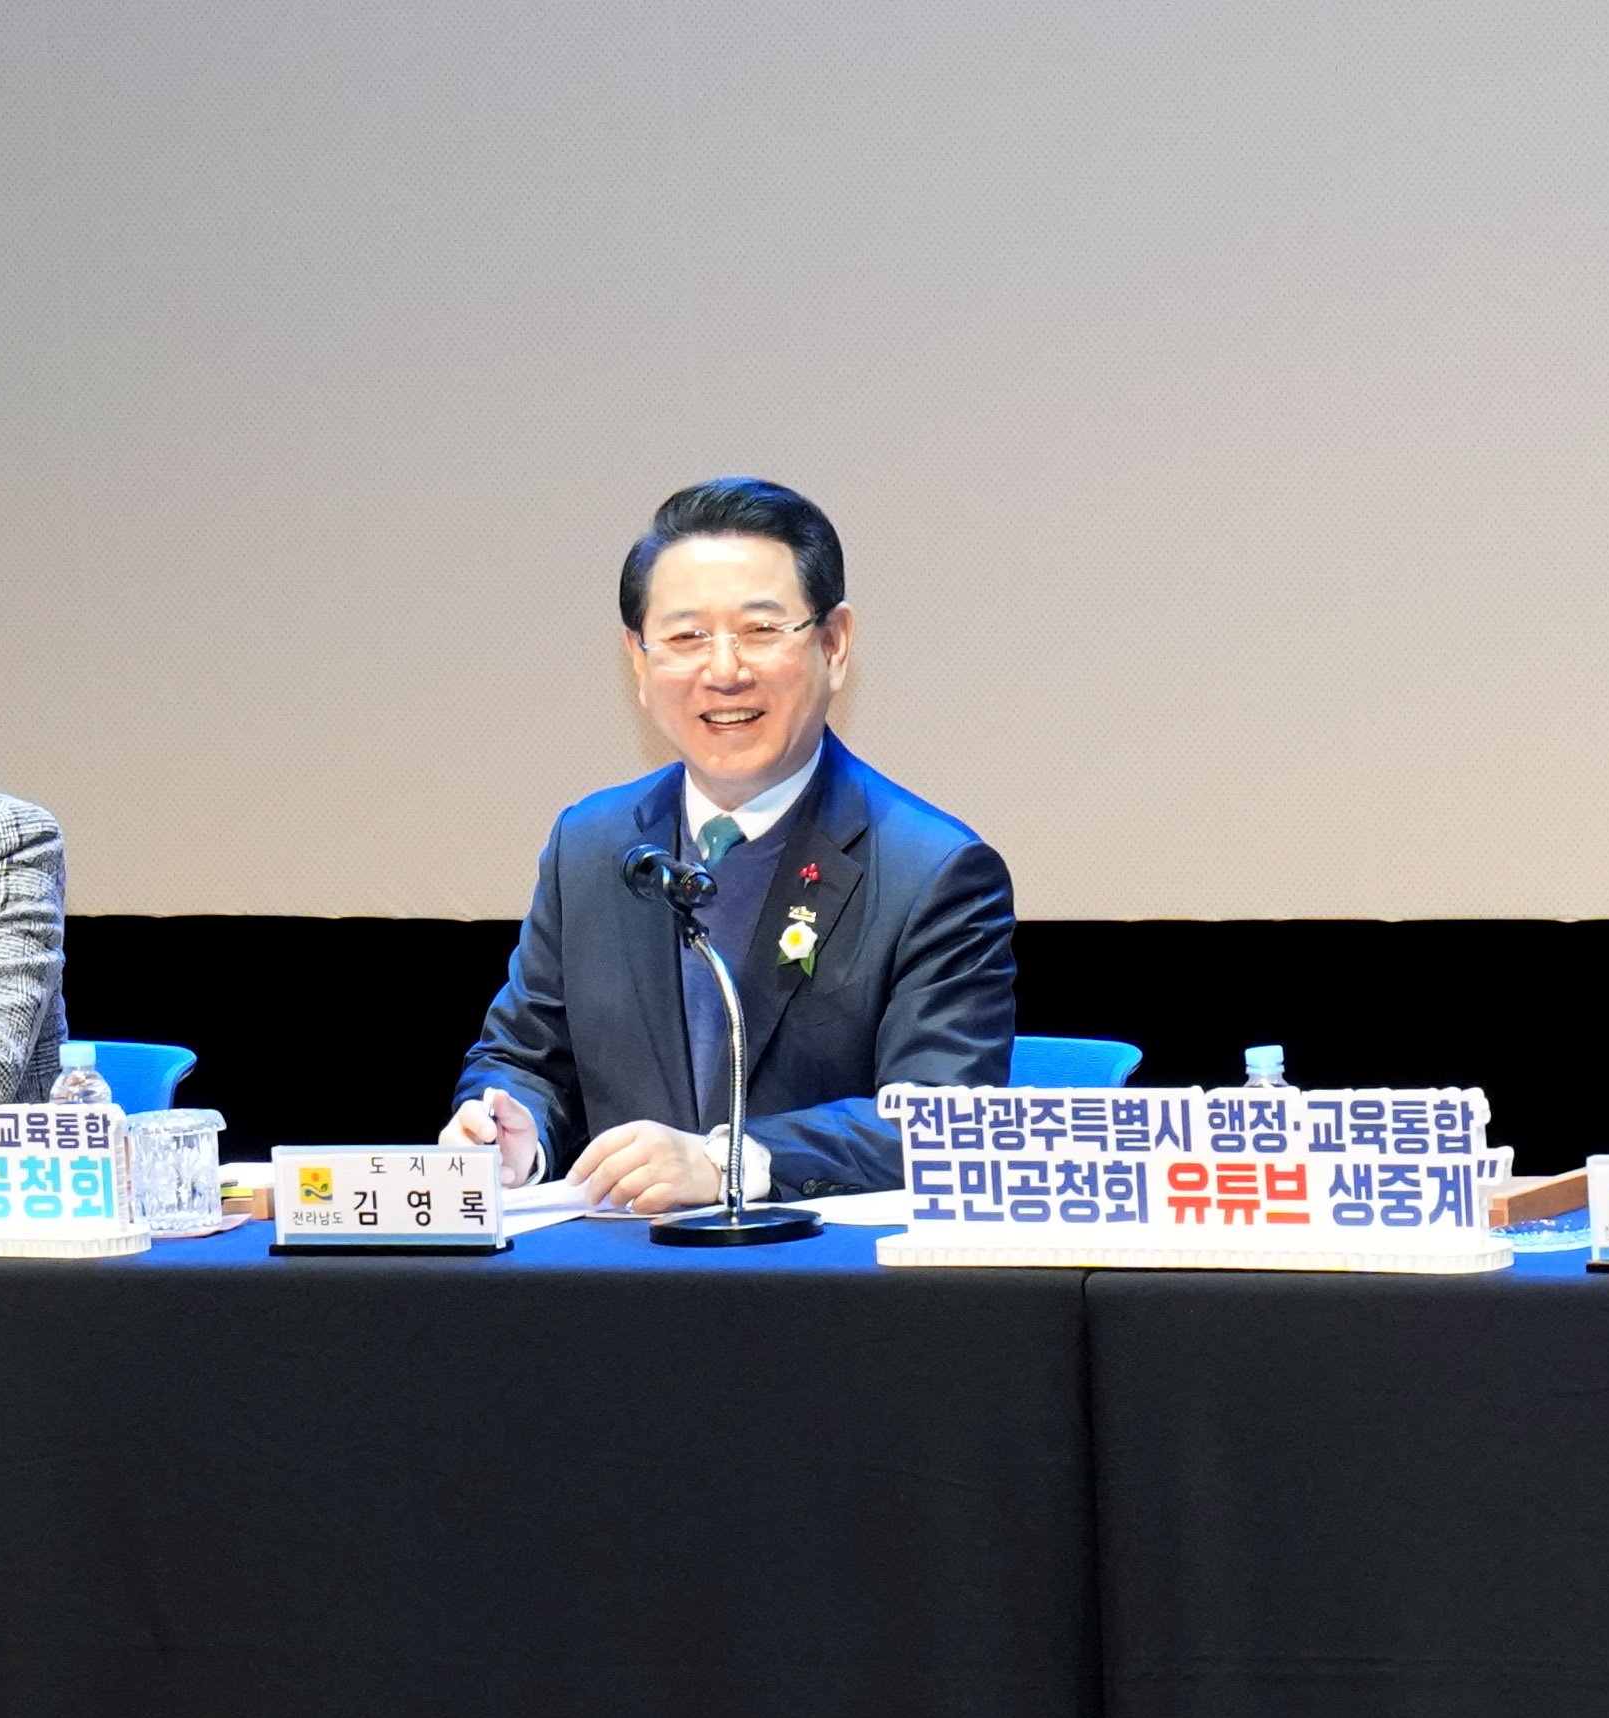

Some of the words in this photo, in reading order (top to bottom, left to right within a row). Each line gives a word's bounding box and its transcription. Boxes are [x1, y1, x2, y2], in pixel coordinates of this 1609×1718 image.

[912, 1160, 1149, 1224] 도민공청회
[1167, 1162, 1311, 1226] 유튜브
[292, 1211, 344, 1226] 전라남도
